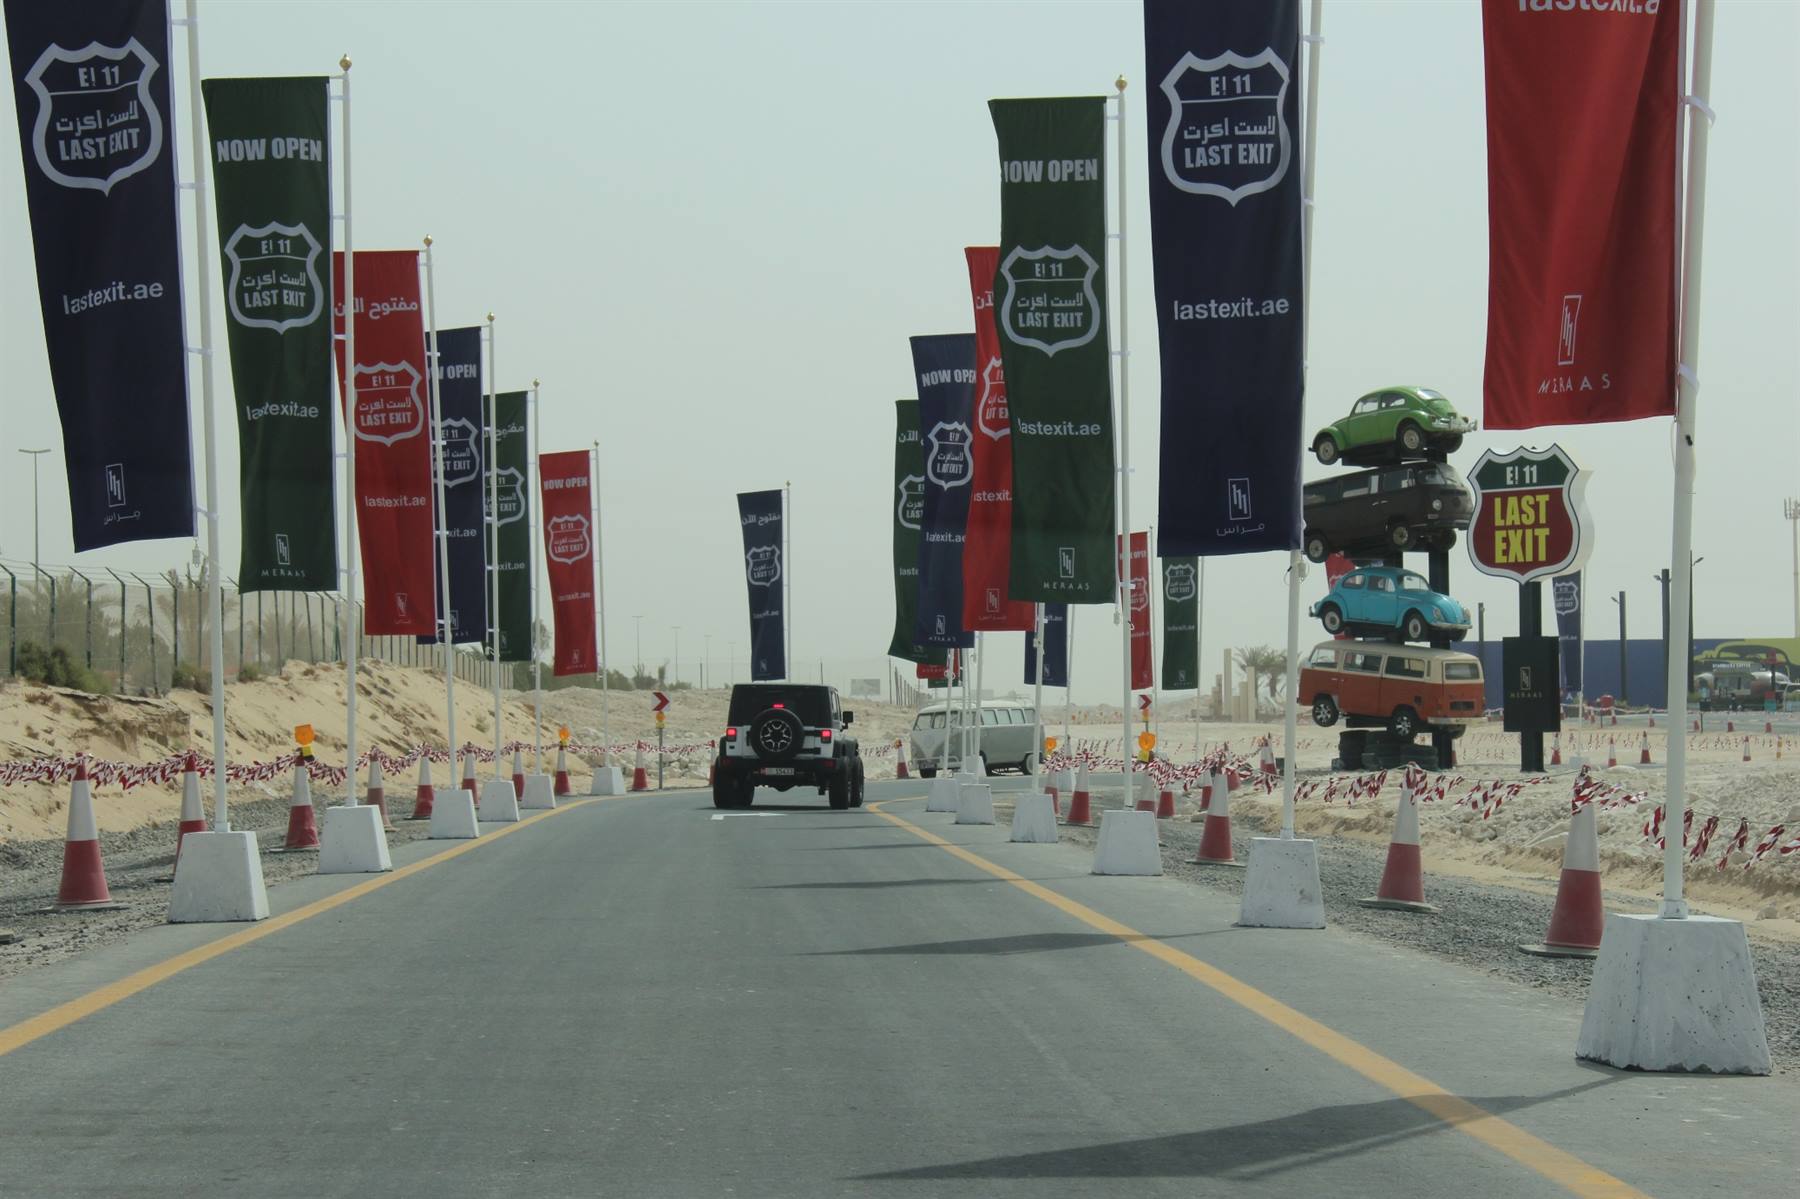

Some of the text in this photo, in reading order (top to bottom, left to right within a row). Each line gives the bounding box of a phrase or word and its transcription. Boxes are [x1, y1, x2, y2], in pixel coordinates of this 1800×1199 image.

[59, 128, 140, 161] LAST EXIT
[216, 137, 322, 162] NOW OPEN
[1184, 143, 1274, 168] LAST EXIT
[1047, 158, 1098, 182] OPEN
[63, 281, 164, 315] lastexit.ae
[244, 290, 306, 308] LAST EXIT
[1173, 297, 1289, 320] lastexit.ae
[1018, 312, 1083, 328] LAST EXIT
[447, 364, 477, 379] OPEN
[922, 369, 951, 387] NOW
[360, 412, 412, 427] LAST EXIT
[453, 460, 471, 470] EXIT
[544, 477, 587, 490] NOW OPEN
[365, 495, 426, 508] lastexit.ae
[1494, 494, 1550, 526] LAST
[1495, 527, 1550, 563] EXIT
